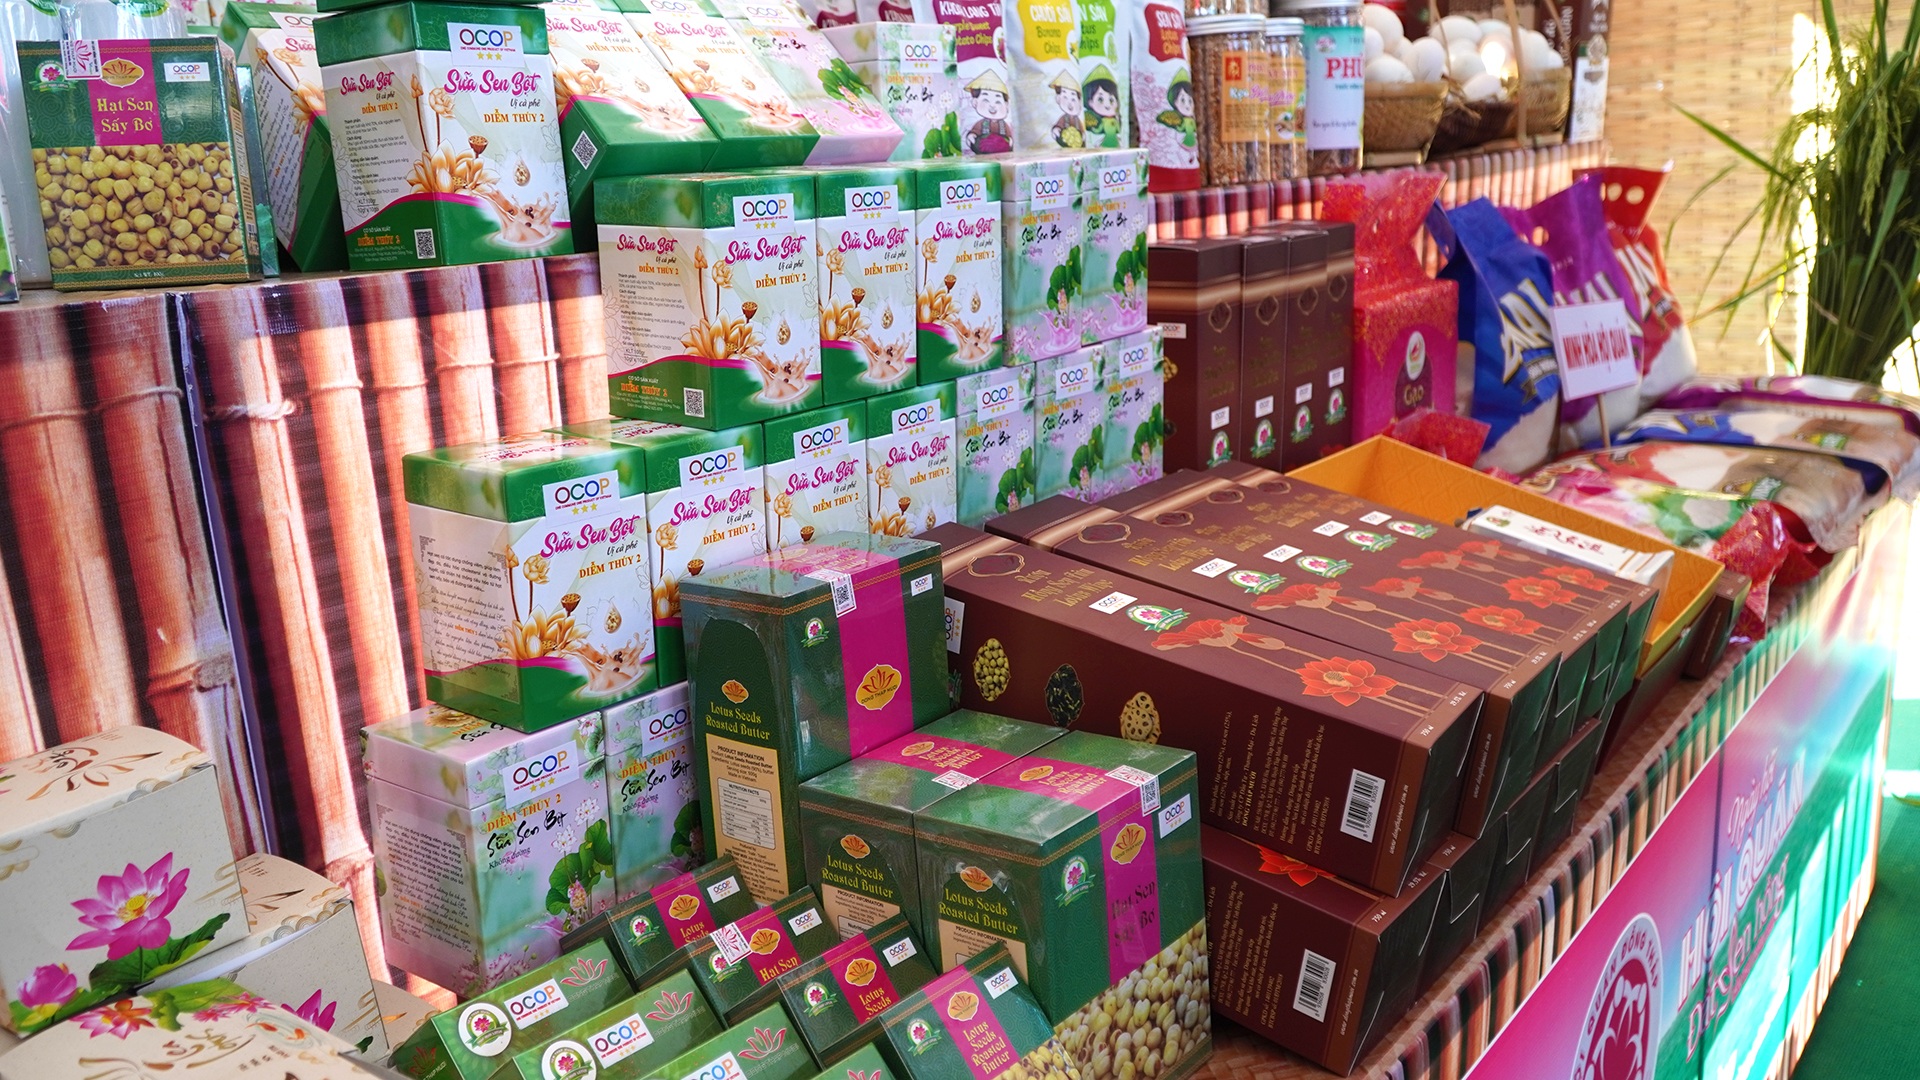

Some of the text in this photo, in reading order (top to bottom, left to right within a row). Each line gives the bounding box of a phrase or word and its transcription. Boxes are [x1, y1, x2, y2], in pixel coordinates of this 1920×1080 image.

[571, 17, 622, 35] Sen Bột
[1155, 10, 1171, 28] SEN
[459, 28, 513, 47] OCOP
[679, 23, 705, 36] Sen
[704, 24, 727, 38] Bột
[904, 44, 936, 58] OCOP
[1044, 40, 1061, 55] Chips
[173, 65, 200, 73] OCOP
[358, 73, 375, 92] Sen
[376, 71, 395, 92] Bột
[444, 68, 541, 97] Sữa Sen Bột
[97, 98, 153, 114] Hạt Sen
[101, 118, 128, 135] Sấy
[540, 113, 545, 122] 2
[1104, 168, 1132, 184] OCOP
[946, 183, 980, 200] OCOP
[1035, 179, 1064, 195] OCOP
[742, 200, 787, 217] OCOP
[852, 191, 890, 208] OCOP
[955, 219, 976, 238] Sen
[976, 217, 995, 238] Bột
[637, 235, 656, 252] Sen
[657, 237, 678, 254] Bột
[838, 227, 909, 253] Sữa Sen Bột
[724, 235, 807, 265] Sữa Sen Bột
[802, 273, 806, 281] 2
[1123, 347, 1148, 364] OCOP
[1060, 368, 1088, 385] OCOP
[982, 386, 1014, 405] OCOP
[898, 406, 934, 426] OCOP
[801, 426, 841, 449] OCOP
[909, 441, 929, 461] Sen
[930, 436, 950, 457] Bột
[689, 452, 737, 476] OCOP
[785, 459, 859, 496] Sữa Sen Bột
[554, 477, 610, 503] OCOP
[670, 485, 752, 526] Sữa Sen Bột
[540, 515, 640, 558] Sữa Sen Bột
[751, 523, 756, 531] 2
[579, 561, 605, 578] DIỄM
[636, 554, 641, 563] 2
[914, 577, 929, 588] OCOP
[710, 702, 761, 724] Lotus Seeds
[706, 714, 770, 740] Roasted Butter
[681, 745, 687, 754] 2
[513, 750, 567, 784] OCOP
[647, 769, 667, 791] Sen
[556, 794, 562, 804] 2
[1165, 801, 1185, 821] OCOP
[517, 820, 540, 845] Sen
[828, 857, 884, 881] Lotus Seeds
[713, 880, 732, 894] OCOP
[821, 868, 894, 898] Roasted Butter
[945, 888, 1008, 916] Lotus Seeds
[795, 912, 812, 926] OCOP
[939, 902, 1018, 934] Roasted Butter
[679, 921, 706, 938] Lotus
[889, 942, 908, 957] OCOP
[777, 956, 798, 971] Sen
[990, 972, 1008, 988] OCOP
[510, 984, 556, 1016] OCOP
[859, 987, 885, 1007] Lotus
[865, 995, 892, 1014] Seeds
[594, 1019, 641, 1053] OCOP
[963, 1021, 989, 1042] Lotus
[970, 1030, 996, 1052] Seeds
[970, 1037, 1006, 1067] Roasted
[981, 1051, 1010, 1075] Butter
